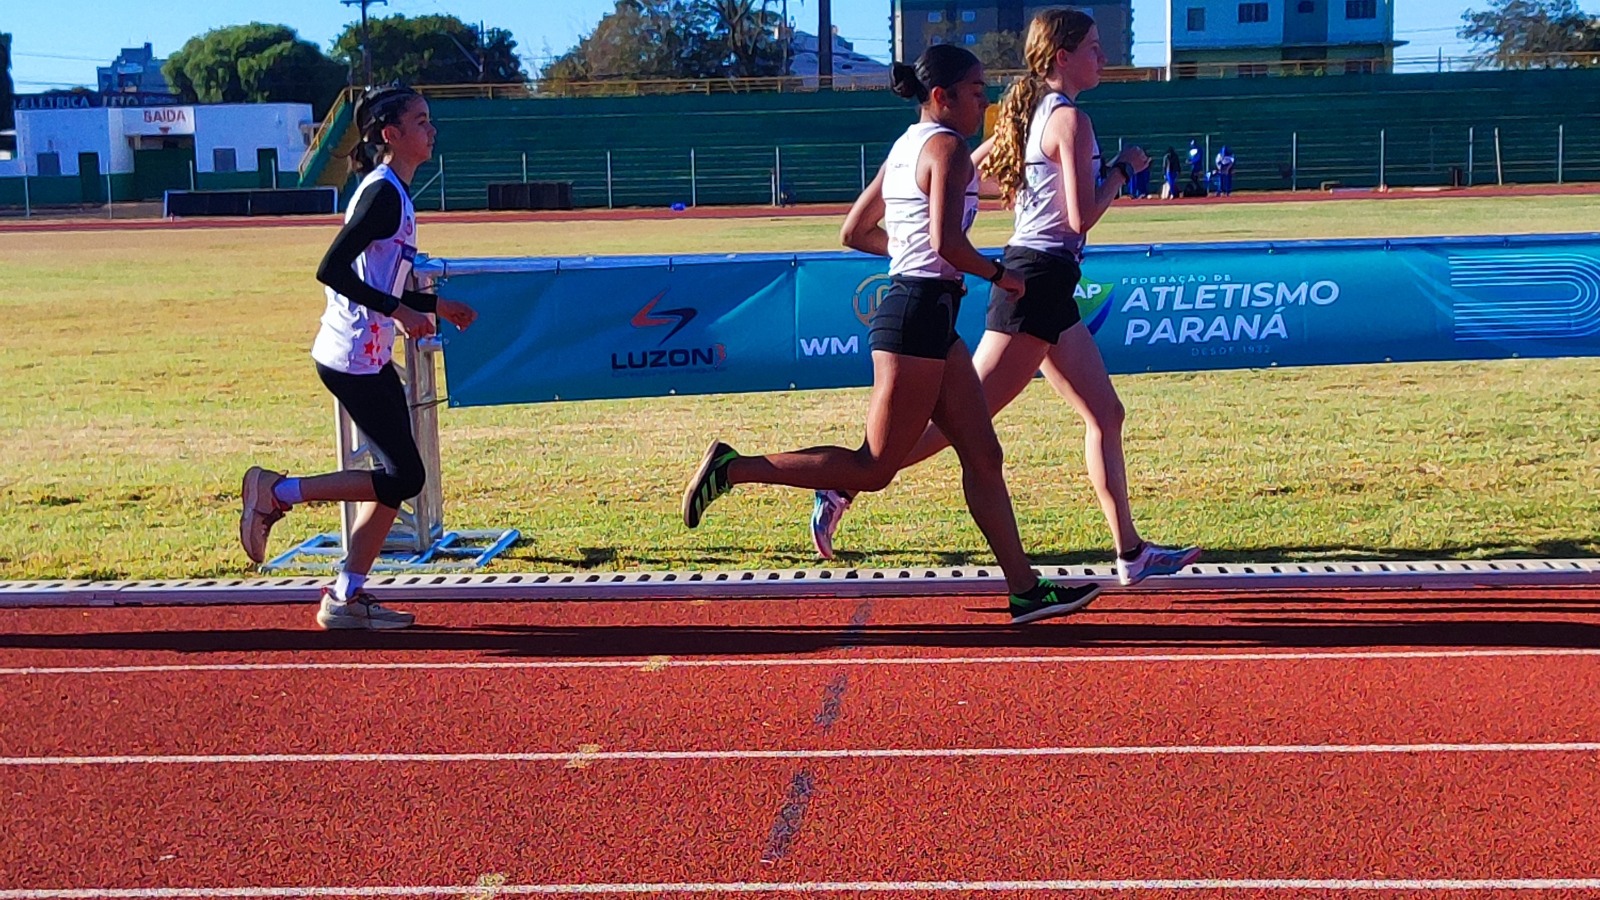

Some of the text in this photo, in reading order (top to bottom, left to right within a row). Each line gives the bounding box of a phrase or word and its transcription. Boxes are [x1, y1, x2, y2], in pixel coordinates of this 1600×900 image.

[1213, 274, 1231, 282] DE
[1120, 280, 1340, 313] ATLETISMO
[1124, 306, 1289, 346] PARANÁ
[800, 335, 859, 356] WM
[611, 347, 714, 370] LUZON
